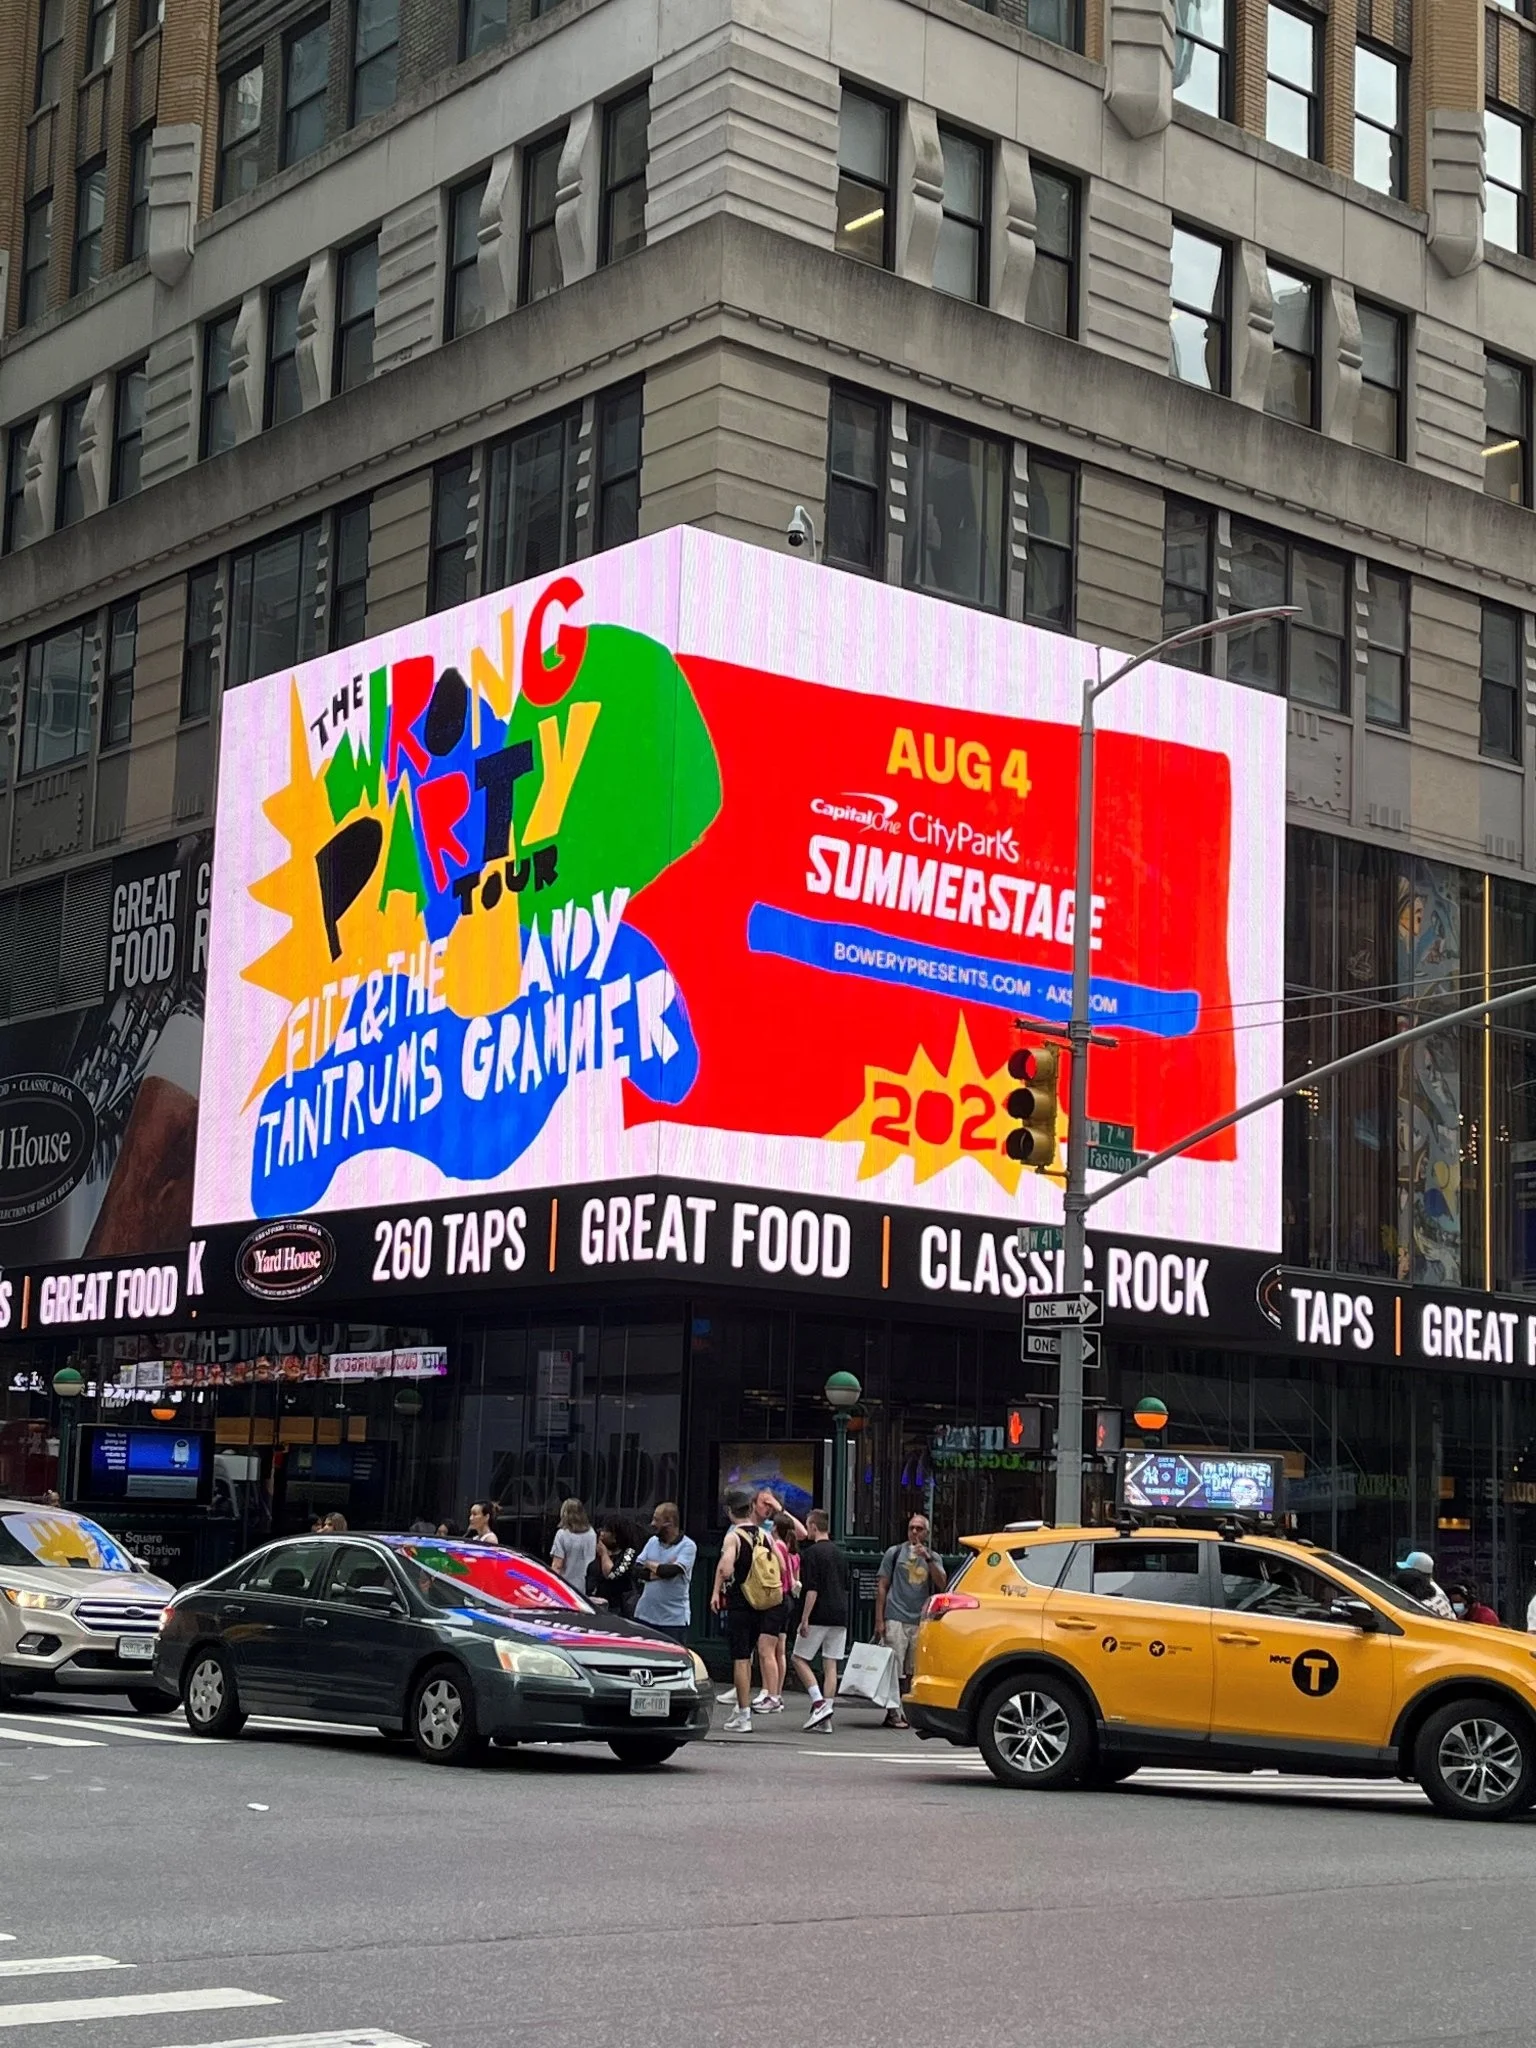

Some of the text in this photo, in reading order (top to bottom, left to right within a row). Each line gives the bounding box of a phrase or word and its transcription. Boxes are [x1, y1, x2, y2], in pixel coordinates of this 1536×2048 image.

[311, 674, 363, 750] THE
[325, 577, 589, 827] WRONG
[886, 726, 1032, 799] AUG 4
[315, 702, 602, 959] PARTY
[112, 868, 181, 934] GREAT
[453, 845, 558, 915] TOUR
[806, 834, 1106, 951] SUMMERSTAGE
[107, 923, 175, 992] FOOD
[520, 886, 631, 998] ANDY
[834, 941, 1032, 998] BOWERYPRESENTS.COM
[461, 968, 680, 1101] GRAMMER
[259, 1028, 443, 1177] TANTRUMS
[871, 1080, 1007, 1155] 202
[1107, 1125, 1113, 1144] 7
[7, 1126, 71, 1170] House
[1090, 1148, 1132, 1172] Fashion
[254, 1246, 322, 1274] Yard House
[372, 1206, 527, 1282] 260 TAPS
[580, 1193, 852, 1279] GREAT FOOD
[1041, 1229, 1053, 1248] 41
[40, 1271, 112, 1325] GREAT
[114, 1265, 178, 1319] FOOD
[1035, 1302, 1090, 1317] ONE WAY
[1107, 1247, 1210, 1318] ROCK
[1034, 1338, 1056, 1353] ONE
[1291, 1287, 1374, 1350] TAPS
[1422, 1303, 1519, 1364] GREAT
[125, 1531, 163, 1544] Square
[143, 1544, 181, 1556] Station
[1270, 1655, 1329, 1691] NYC T
